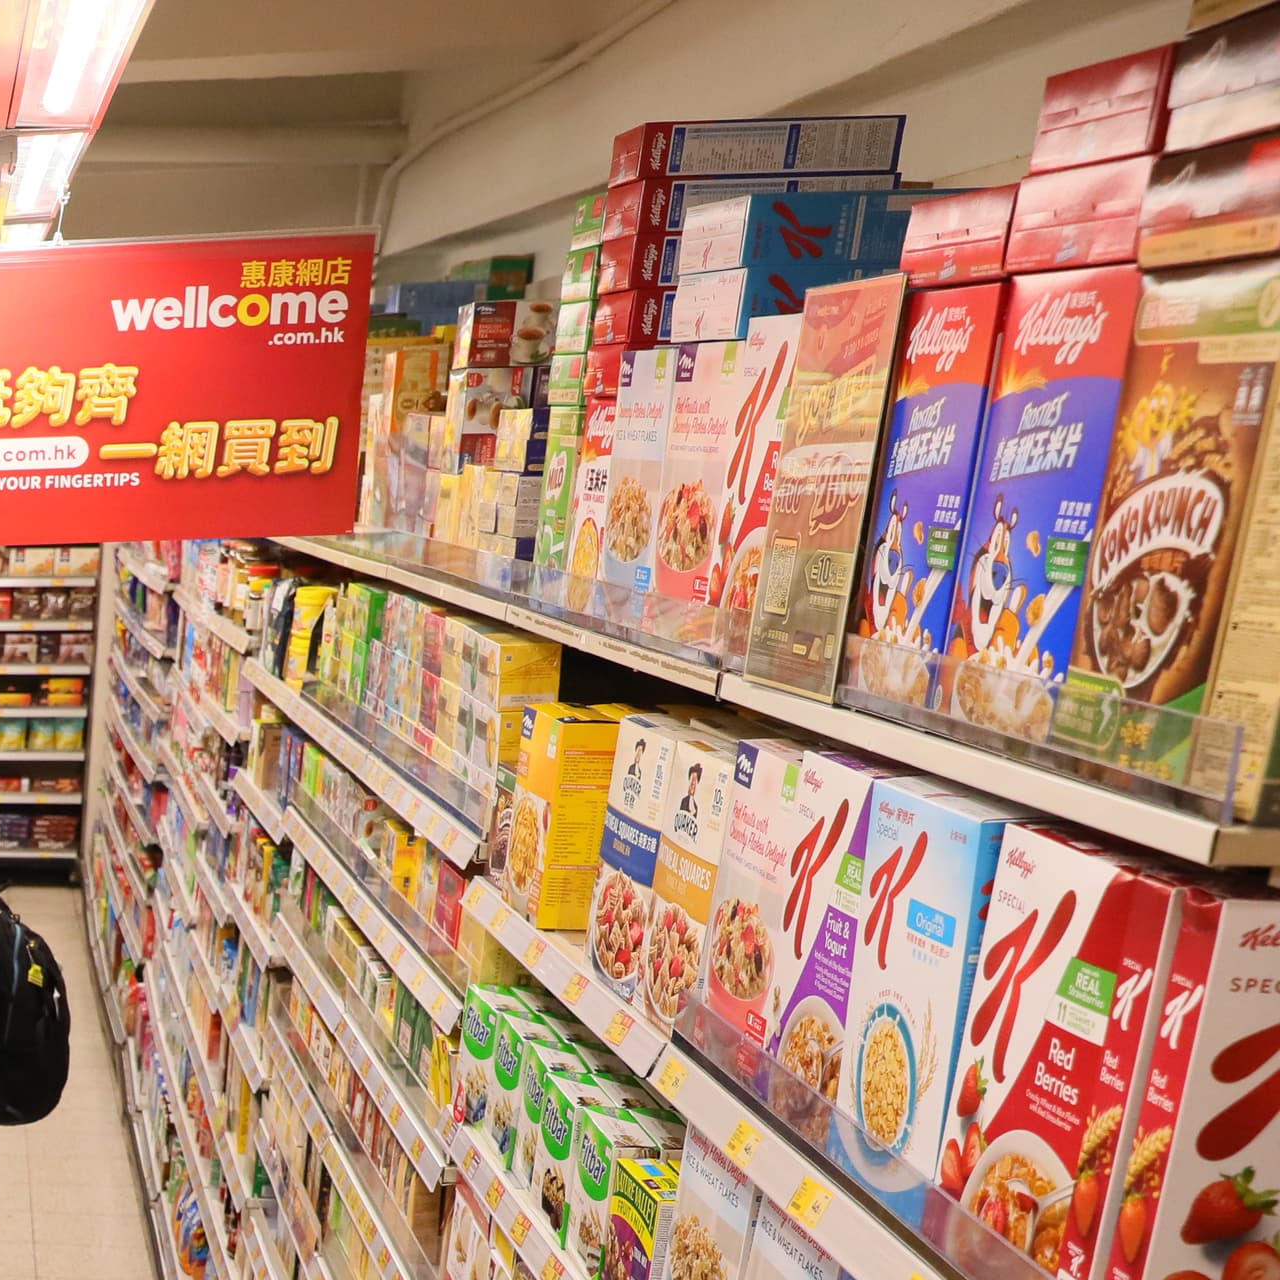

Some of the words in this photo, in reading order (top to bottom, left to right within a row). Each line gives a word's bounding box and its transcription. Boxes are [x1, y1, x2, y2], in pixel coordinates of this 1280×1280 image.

[240, 259, 351, 288] 惠康網店
[111, 285, 348, 331] wellcome
[268, 329, 345, 346] .com.hk
[907, 308, 974, 372] Kellogg's
[1014, 293, 1107, 365] Kellogg's
[46, 472, 140, 490] FINGERTIPS
[826, 911, 843, 931] Fruit
[915, 914, 944, 938] Original
[824, 932, 848, 957] Yogurt
[1075, 973, 1100, 994] REAL
[464, 1007, 490, 1045] Fitbar
[498, 1033, 518, 1079] Fitbar
[1048, 1038, 1074, 1070] Red
[1103, 1049, 1118, 1070] Red
[1034, 1064, 1078, 1105] Berries
[1100, 1064, 1124, 1092] Berries
[1147, 1087, 1174, 1113] Berries
[542, 1095, 569, 1145] Fitbar
